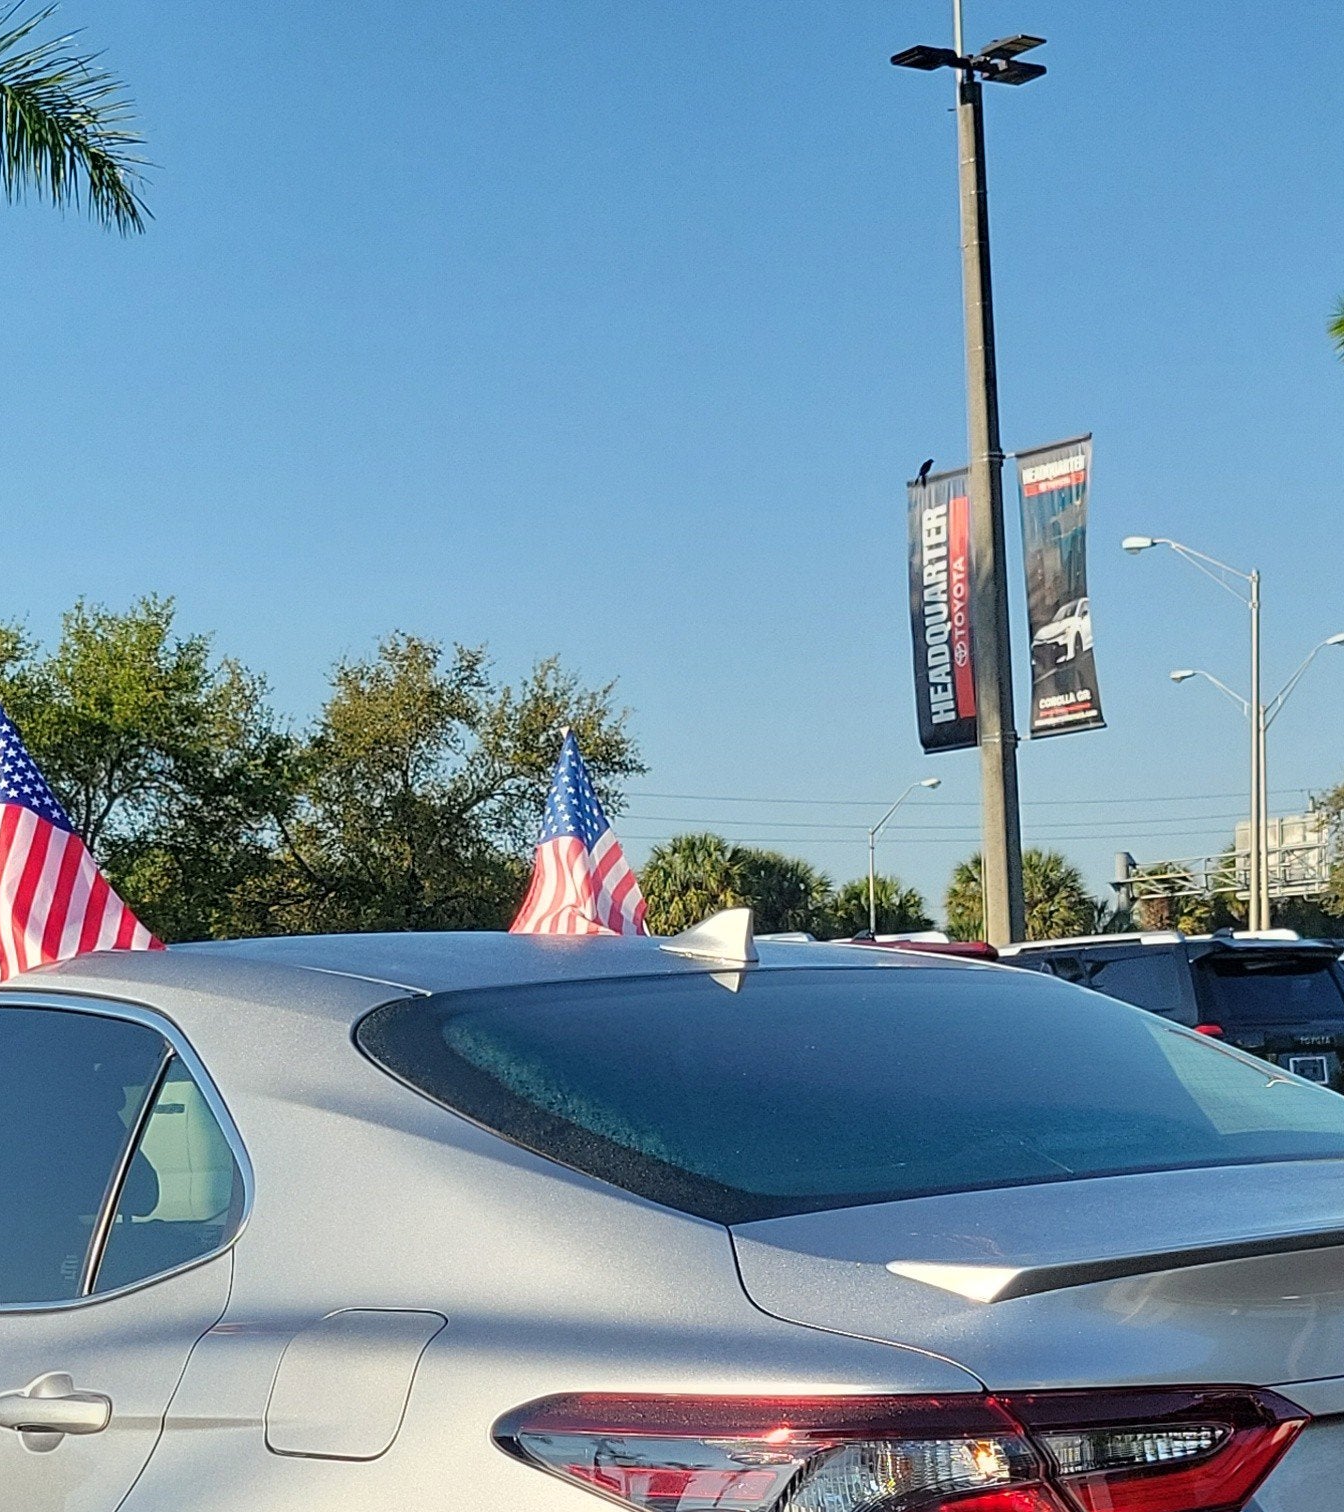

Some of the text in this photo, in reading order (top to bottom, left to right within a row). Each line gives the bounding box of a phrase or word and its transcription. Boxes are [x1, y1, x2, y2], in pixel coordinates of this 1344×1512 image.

[921, 504, 956, 724] HEADQUARTER
[952, 557, 969, 637] TOYOTA
[1039, 692, 1076, 709] COROLLA
